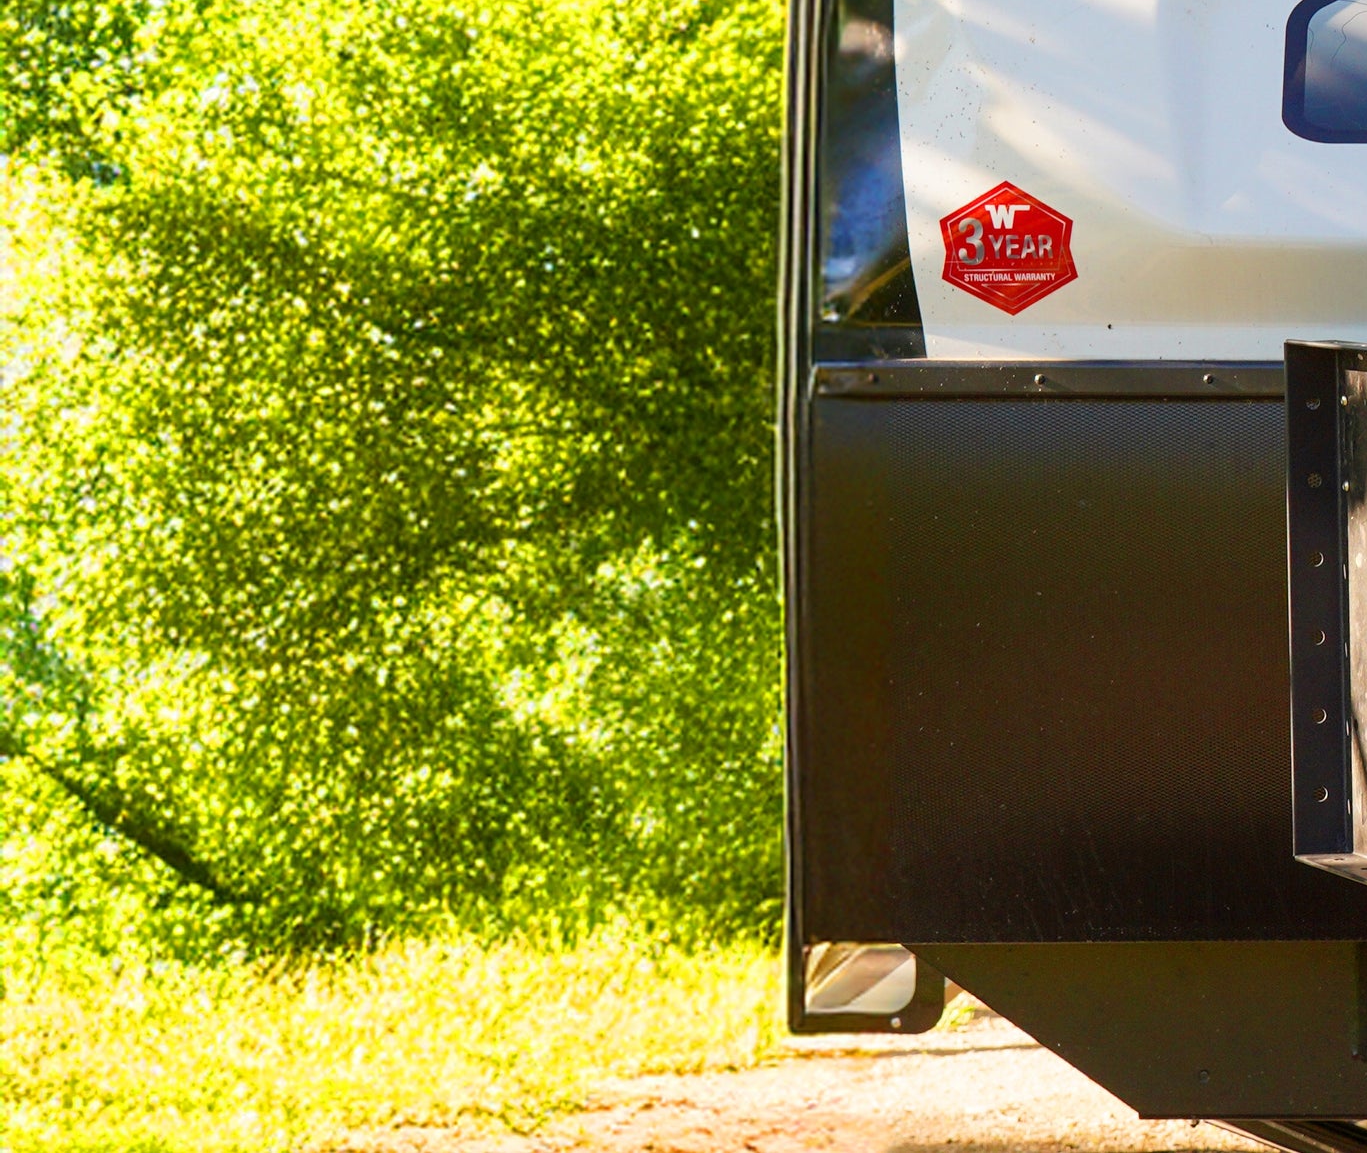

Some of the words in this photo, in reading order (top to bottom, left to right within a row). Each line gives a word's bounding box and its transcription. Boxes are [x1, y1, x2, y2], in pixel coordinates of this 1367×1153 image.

[957, 217, 985, 265] 3
[988, 234, 1053, 259] YEAR
[964, 273, 1013, 282] STRUCTURAL
[1013, 273, 1056, 281] WARRANTY
